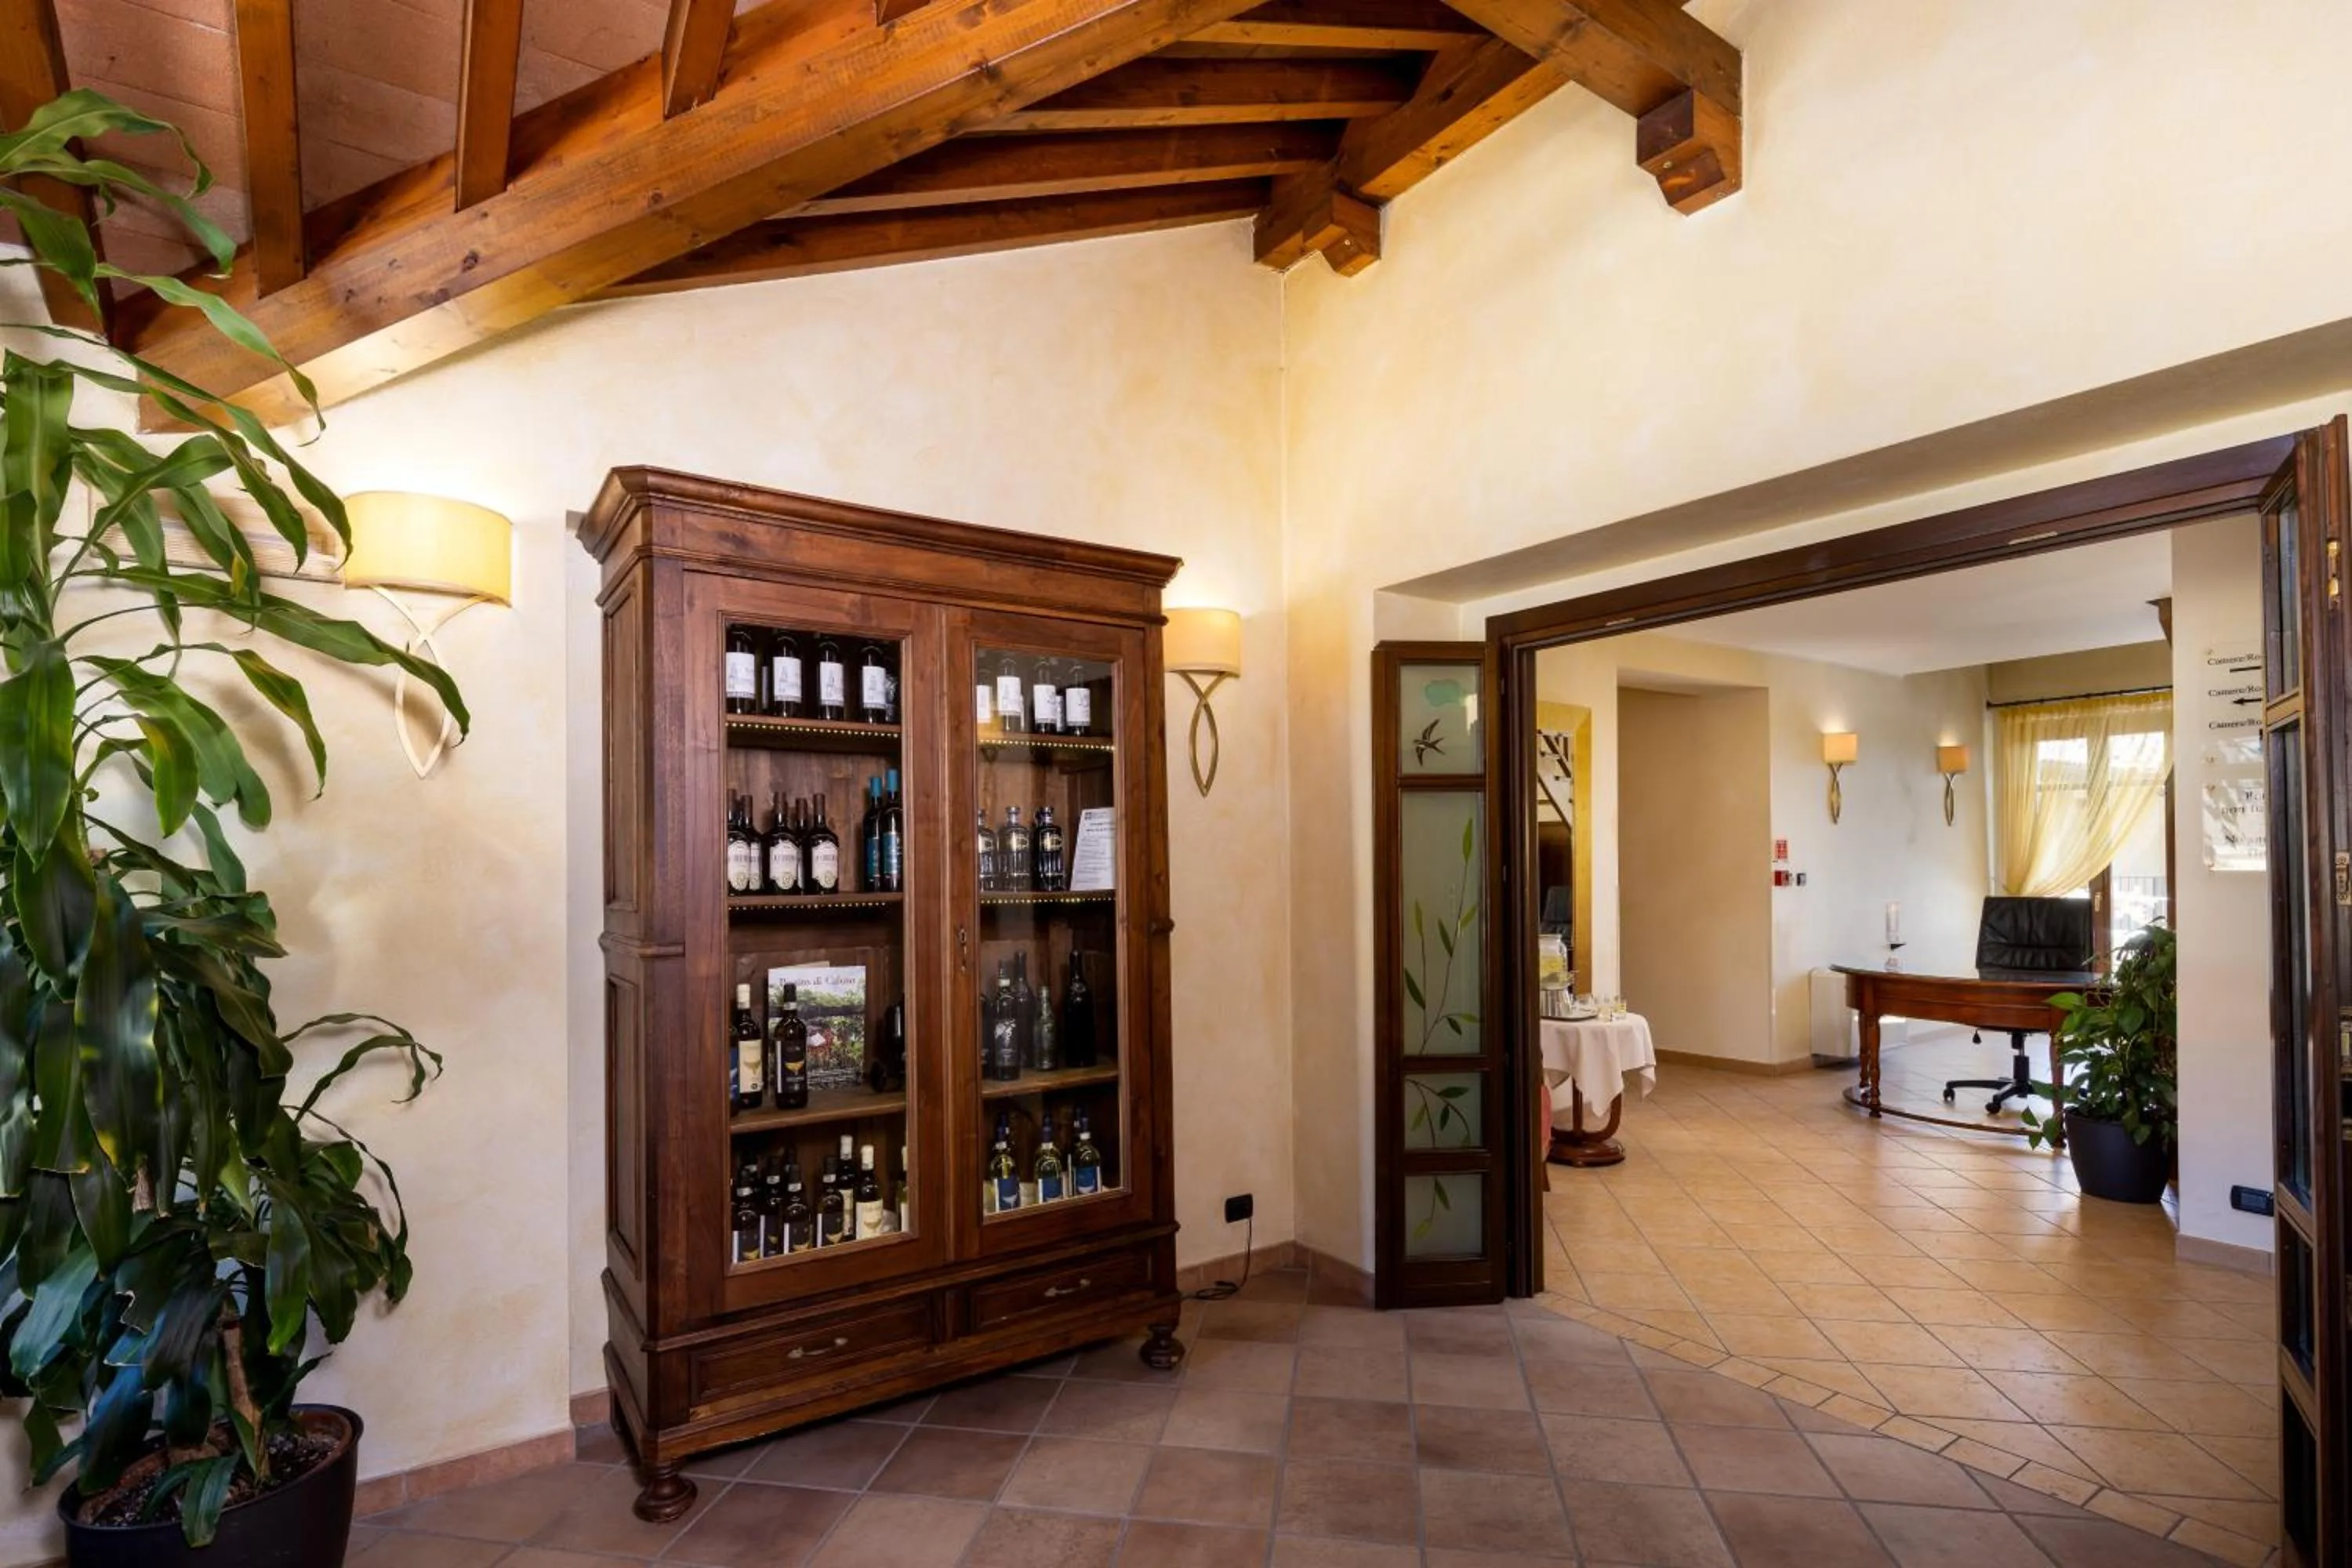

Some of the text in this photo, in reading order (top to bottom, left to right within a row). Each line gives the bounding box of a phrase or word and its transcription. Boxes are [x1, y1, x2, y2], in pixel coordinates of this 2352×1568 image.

[2207, 654, 2262, 666] Camere/Ro
[2208, 685, 2262, 697] Camere/Ro
[2209, 718, 2262, 730] Camere/Ro
